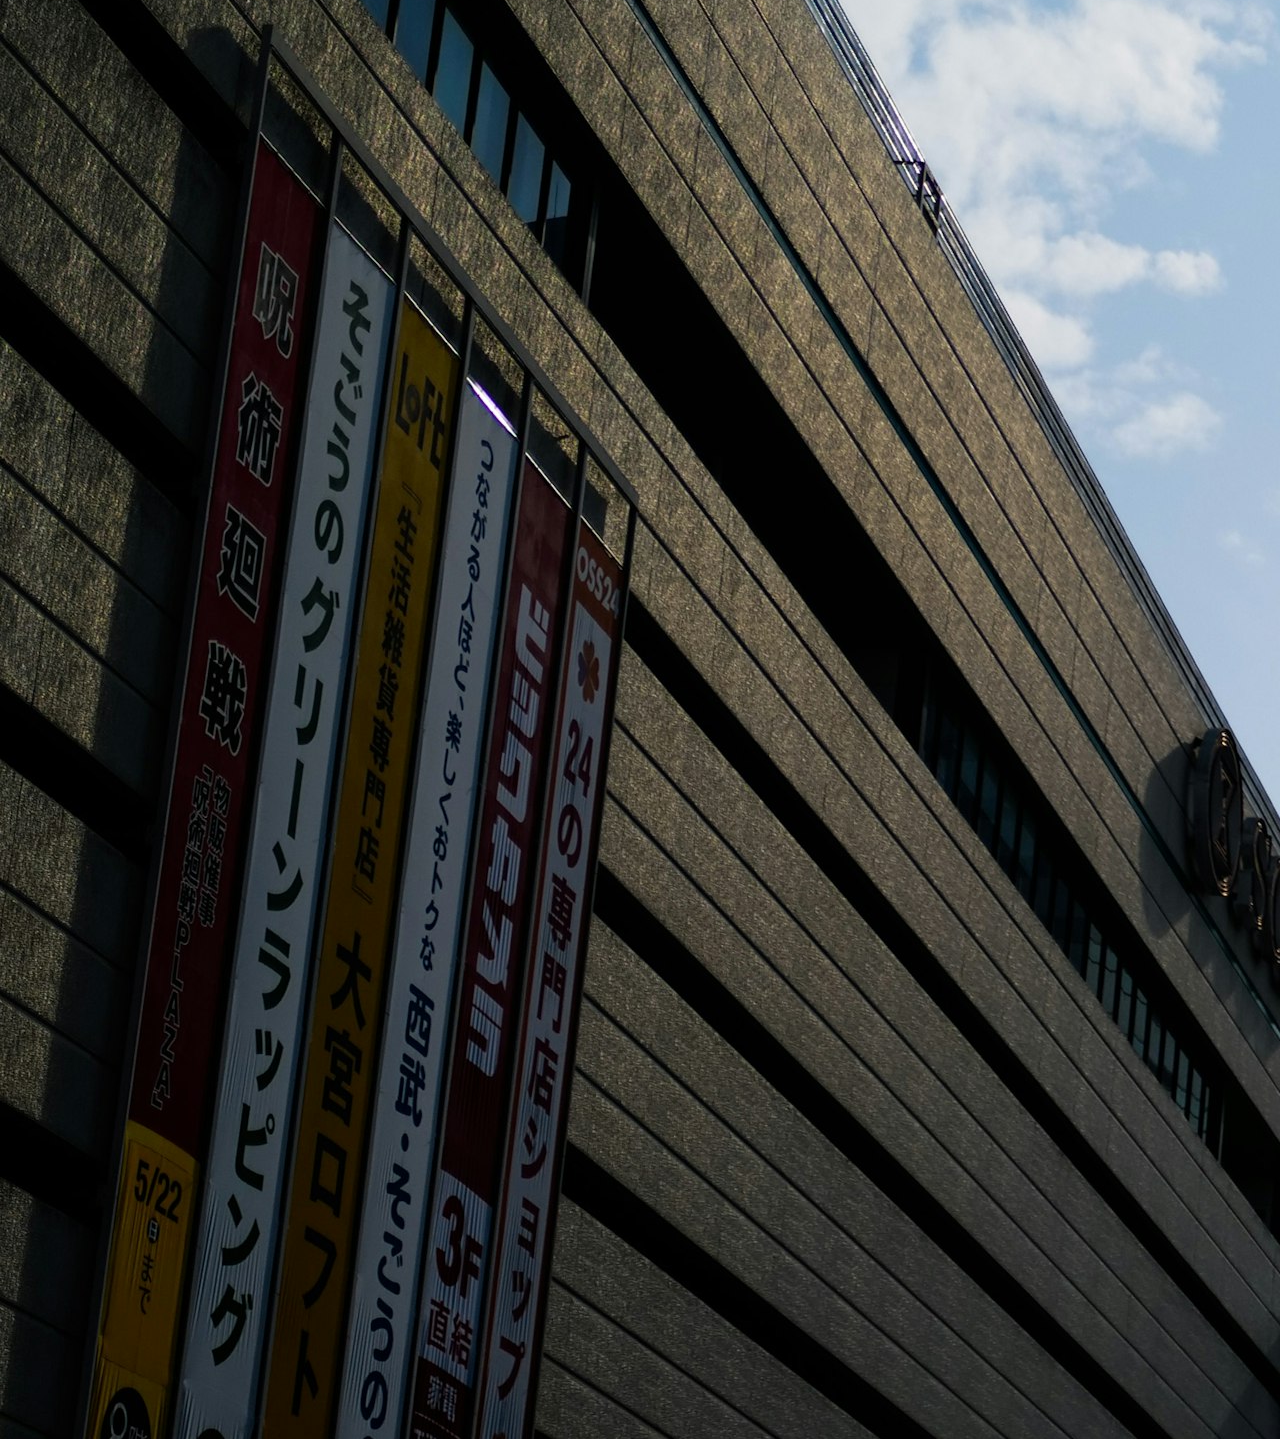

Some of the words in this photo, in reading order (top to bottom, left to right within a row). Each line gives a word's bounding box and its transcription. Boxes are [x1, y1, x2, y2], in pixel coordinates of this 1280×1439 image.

[198, 241, 301, 758] 呪術廻戦
[577, 546, 621, 619] OSS24
[210, 279, 371, 1367] そごうのグリーンラッピング
[497, 718, 594, 1401] 24の専門店ショップ
[133, 1161, 183, 1224] 5/22
[291, 931, 373, 1418] 大宮ロフト
[139, 1253, 156, 1315] まで
[436, 1195, 482, 1300] 3F
[427, 1300, 473, 1369] 直結
[427, 1374, 457, 1423] 家電
